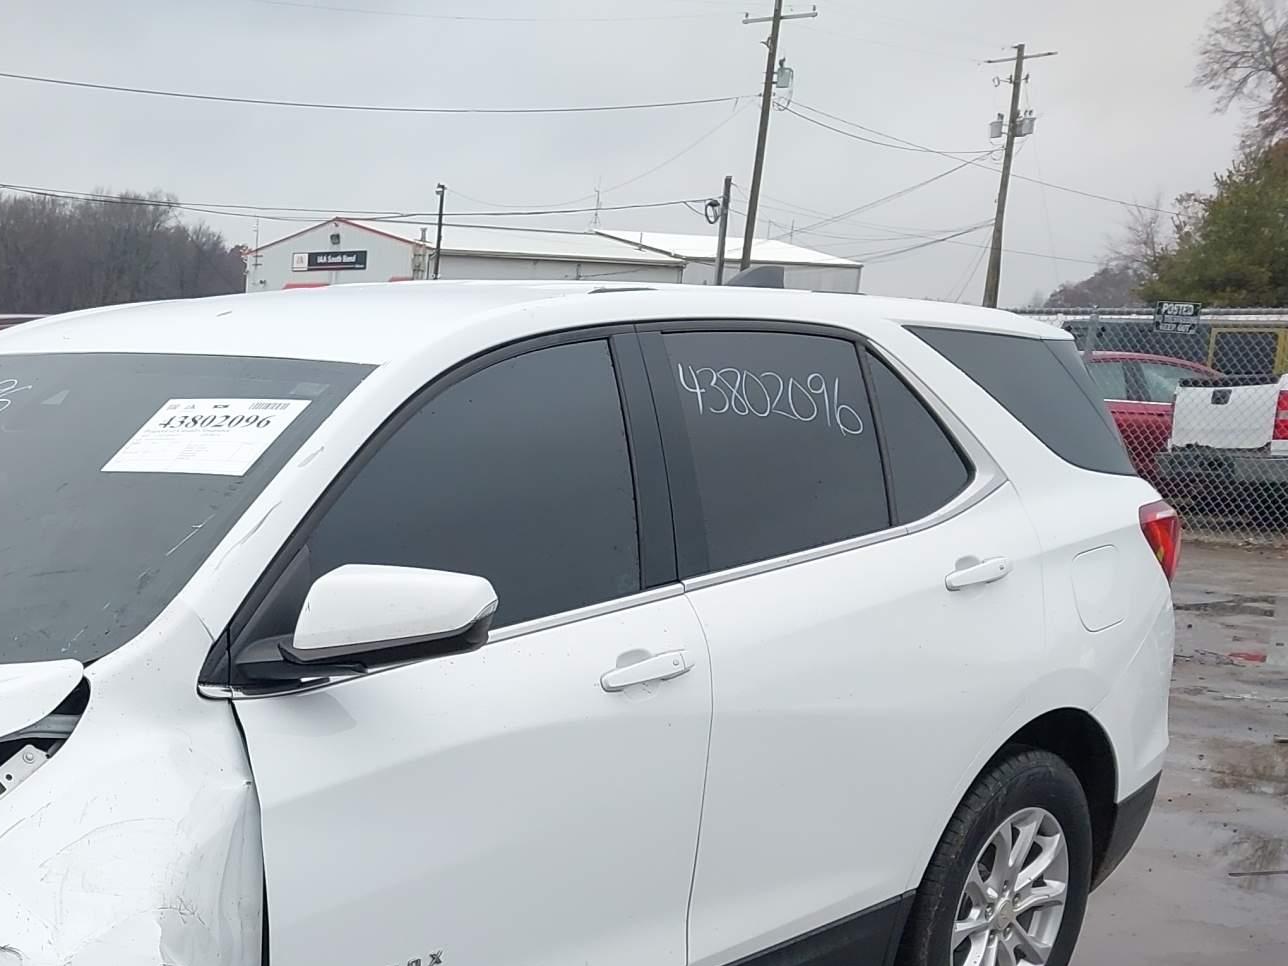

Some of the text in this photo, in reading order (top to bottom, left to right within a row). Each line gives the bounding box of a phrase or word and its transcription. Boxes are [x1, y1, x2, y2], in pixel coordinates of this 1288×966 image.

[1162, 303, 1194, 315] POSTED
[678, 363, 863, 436] 43802096
[158, 414, 277, 429] 43802096
